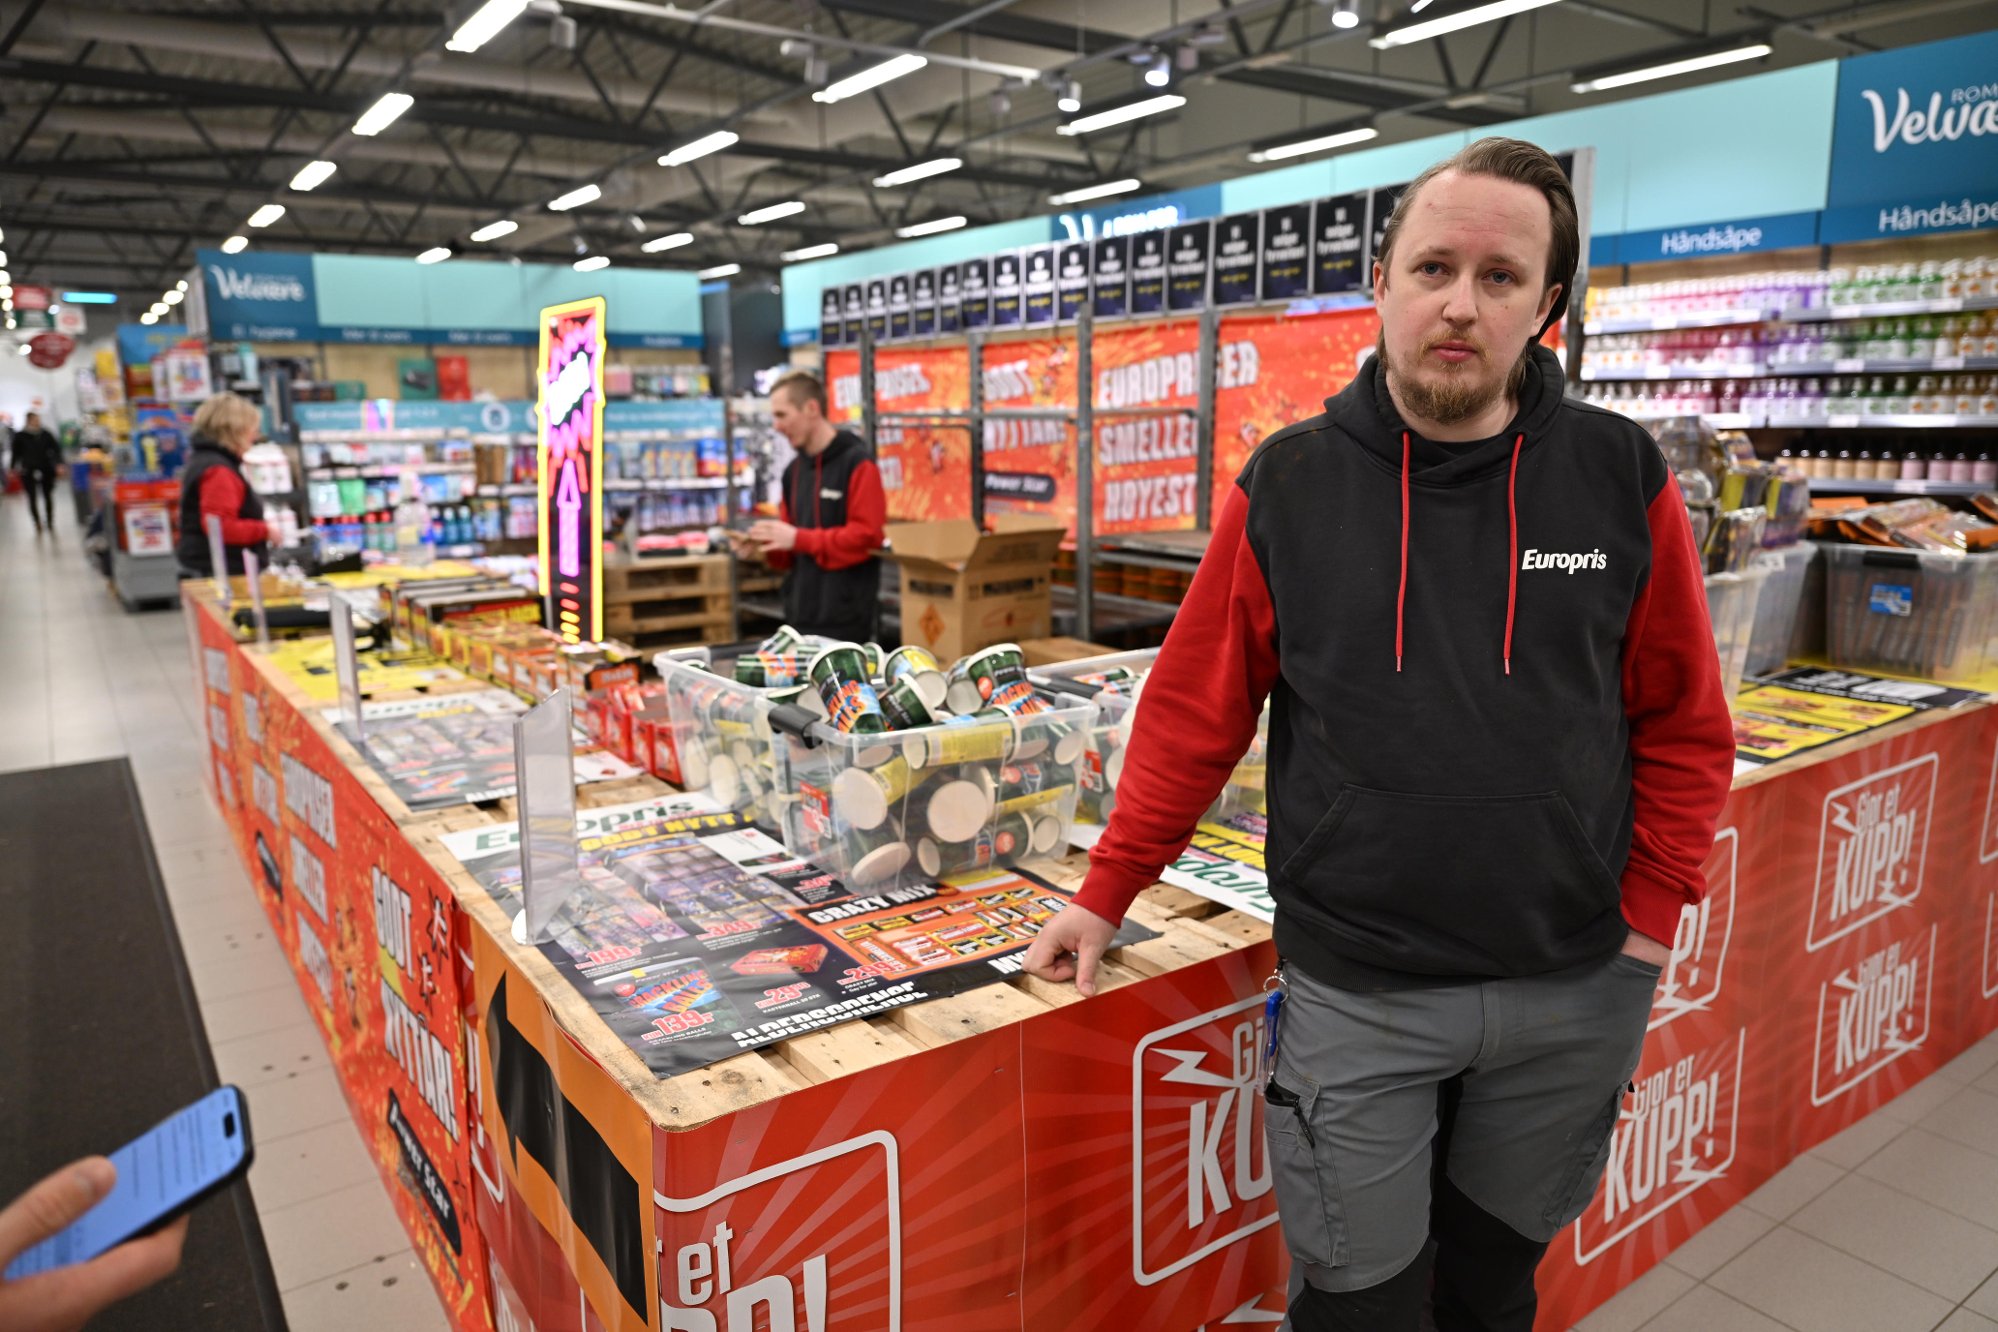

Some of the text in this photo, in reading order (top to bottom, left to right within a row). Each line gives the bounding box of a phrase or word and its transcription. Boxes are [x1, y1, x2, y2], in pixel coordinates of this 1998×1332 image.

[1861, 86, 1998, 153] Velvæ
[1661, 225, 1762, 255] Håndsåpe
[1878, 198, 1998, 233] Håndsåpe
[1101, 413, 1198, 467] SMELLE
[1521, 548, 1607, 574] Europris
[1830, 808, 1917, 922] KUPP!
[808, 883, 938, 924] CRAZY MIX
[1834, 957, 1919, 1077] KUPP!
[1604, 1070, 1719, 1224] KUPP!
[423, 1161, 450, 1220] Star
[677, 1220, 733, 1306] et
